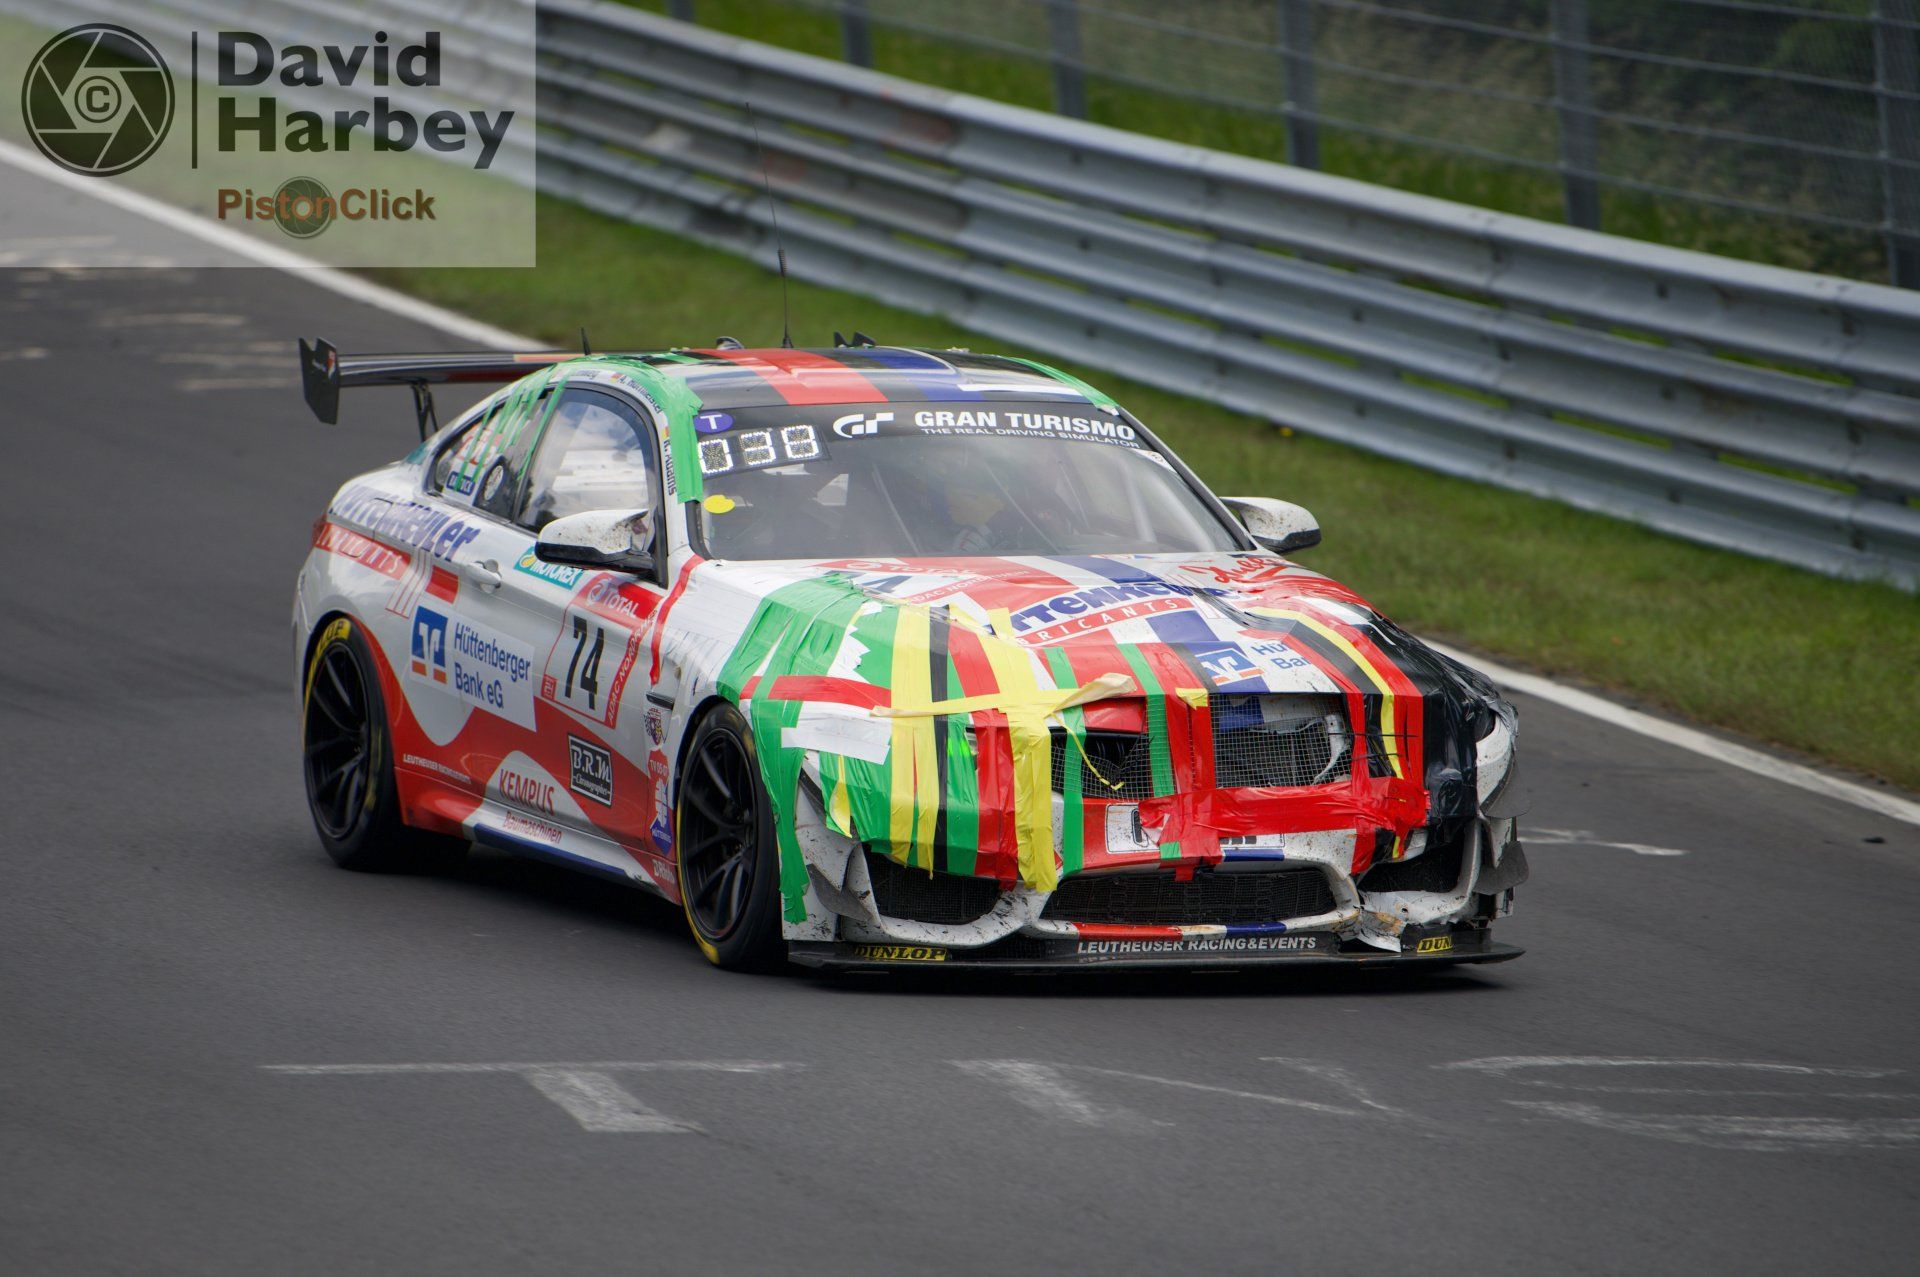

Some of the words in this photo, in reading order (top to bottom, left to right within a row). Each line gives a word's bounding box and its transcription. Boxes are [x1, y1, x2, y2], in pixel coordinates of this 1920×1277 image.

[700, 414, 722, 430] T
[914, 411, 997, 428] GRAN
[1004, 412, 1136, 441] TURISMO
[953, 428, 994, 436] REAL
[995, 428, 1056, 438] DRIVING
[1058, 432, 1141, 449] SIMULATOR
[529, 560, 584, 585] MOTOREX
[602, 588, 640, 619] TOTAL
[1014, 598, 1180, 646] BRICANTS
[454, 622, 531, 682] Hüttenberger
[564, 614, 605, 712] 74
[454, 661, 485, 701] Bank
[486, 679, 504, 709] eG
[500, 768, 555, 817] KEMPUS
[502, 810, 563, 845] Baumaschinen
[854, 946, 946, 960] DUNLOP
[1076, 940, 1184, 955] LEUTHEUSER
[1186, 936, 1317, 952] RACING&EVENTS
[1417, 938, 1453, 953] DUN
